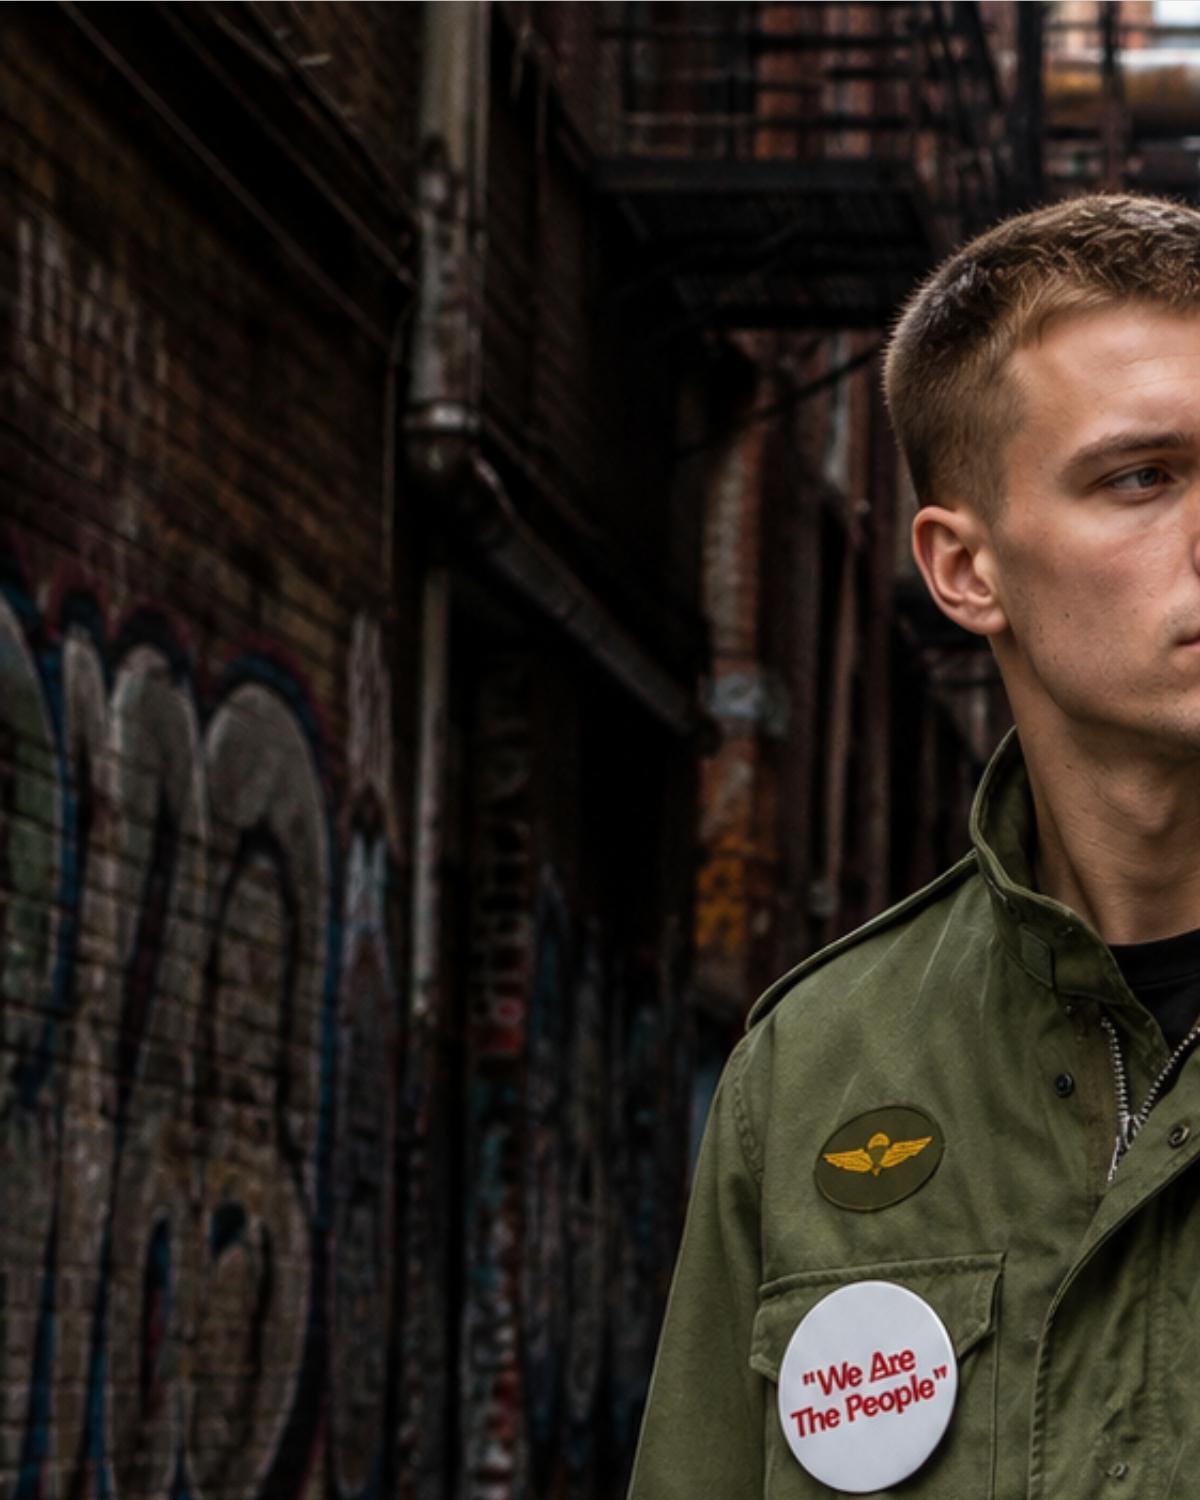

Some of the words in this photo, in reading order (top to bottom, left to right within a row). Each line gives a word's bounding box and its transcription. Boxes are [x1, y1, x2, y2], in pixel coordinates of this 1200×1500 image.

[790, 1406, 841, 1438] The
[845, 1365, 948, 1423] People"
[803, 1361, 863, 1396] "We
[869, 1349, 916, 1383] Are
